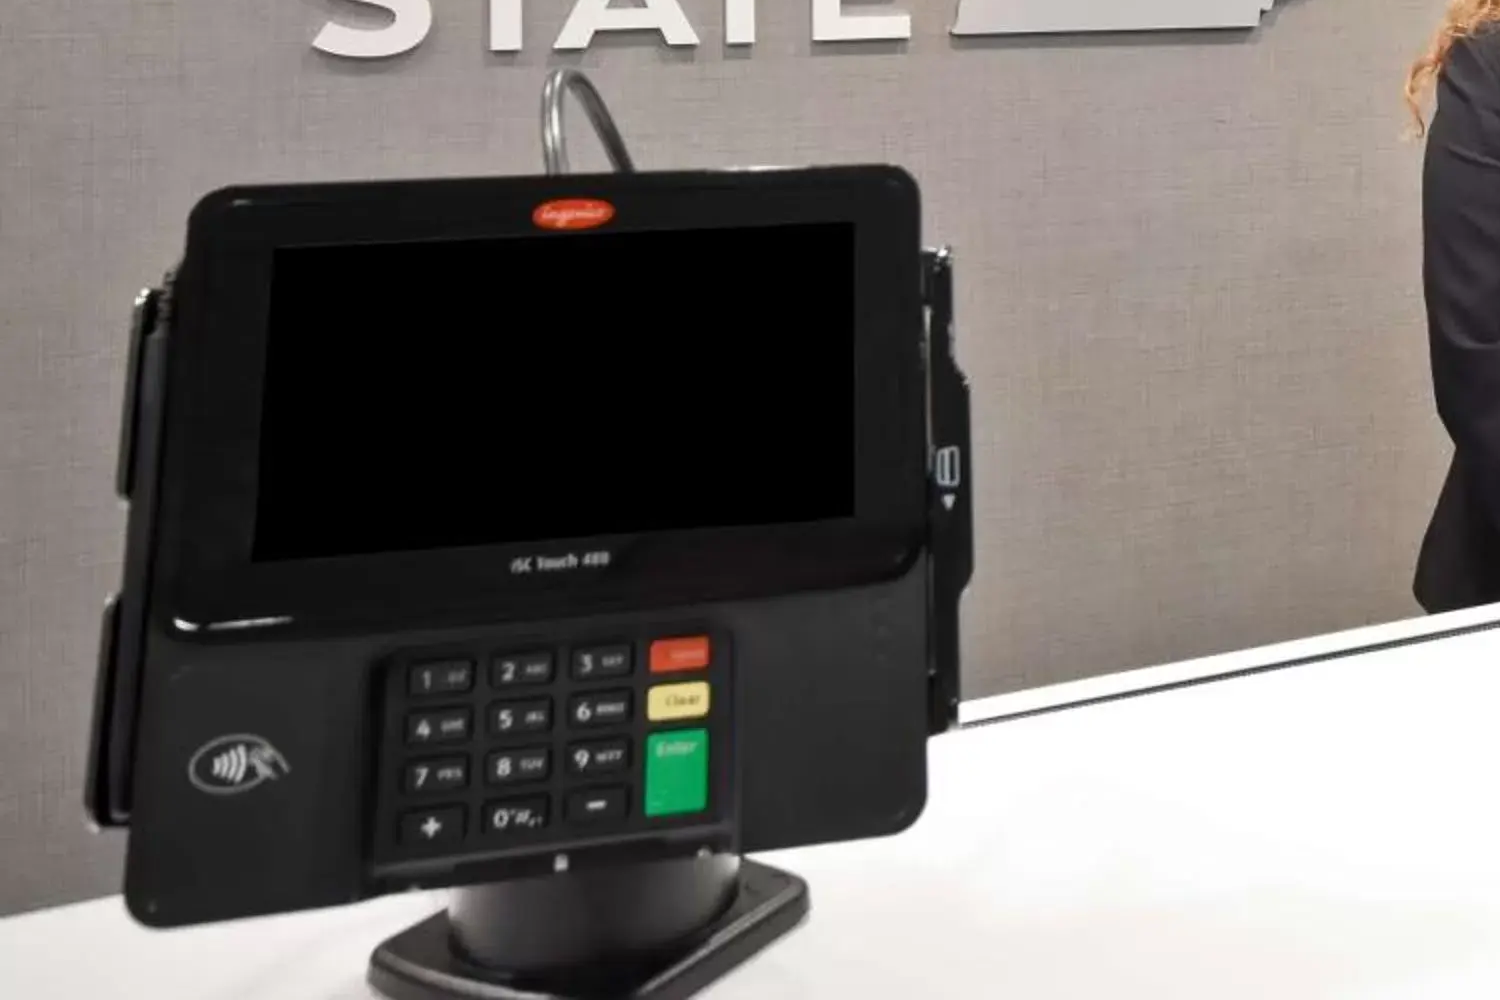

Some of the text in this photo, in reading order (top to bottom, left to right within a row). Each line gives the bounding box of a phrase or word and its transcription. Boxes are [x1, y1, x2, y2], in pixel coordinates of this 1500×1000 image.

[501, 661, 515, 682] 2
[579, 653, 593, 674] 3
[421, 669, 433, 690] 1
[498, 709, 513, 730] 5
[575, 703, 591, 722] 6
[416, 719, 432, 739] 4
[496, 756, 511, 778] 8
[574, 749, 589, 771] 9
[415, 766, 430, 790] 7
